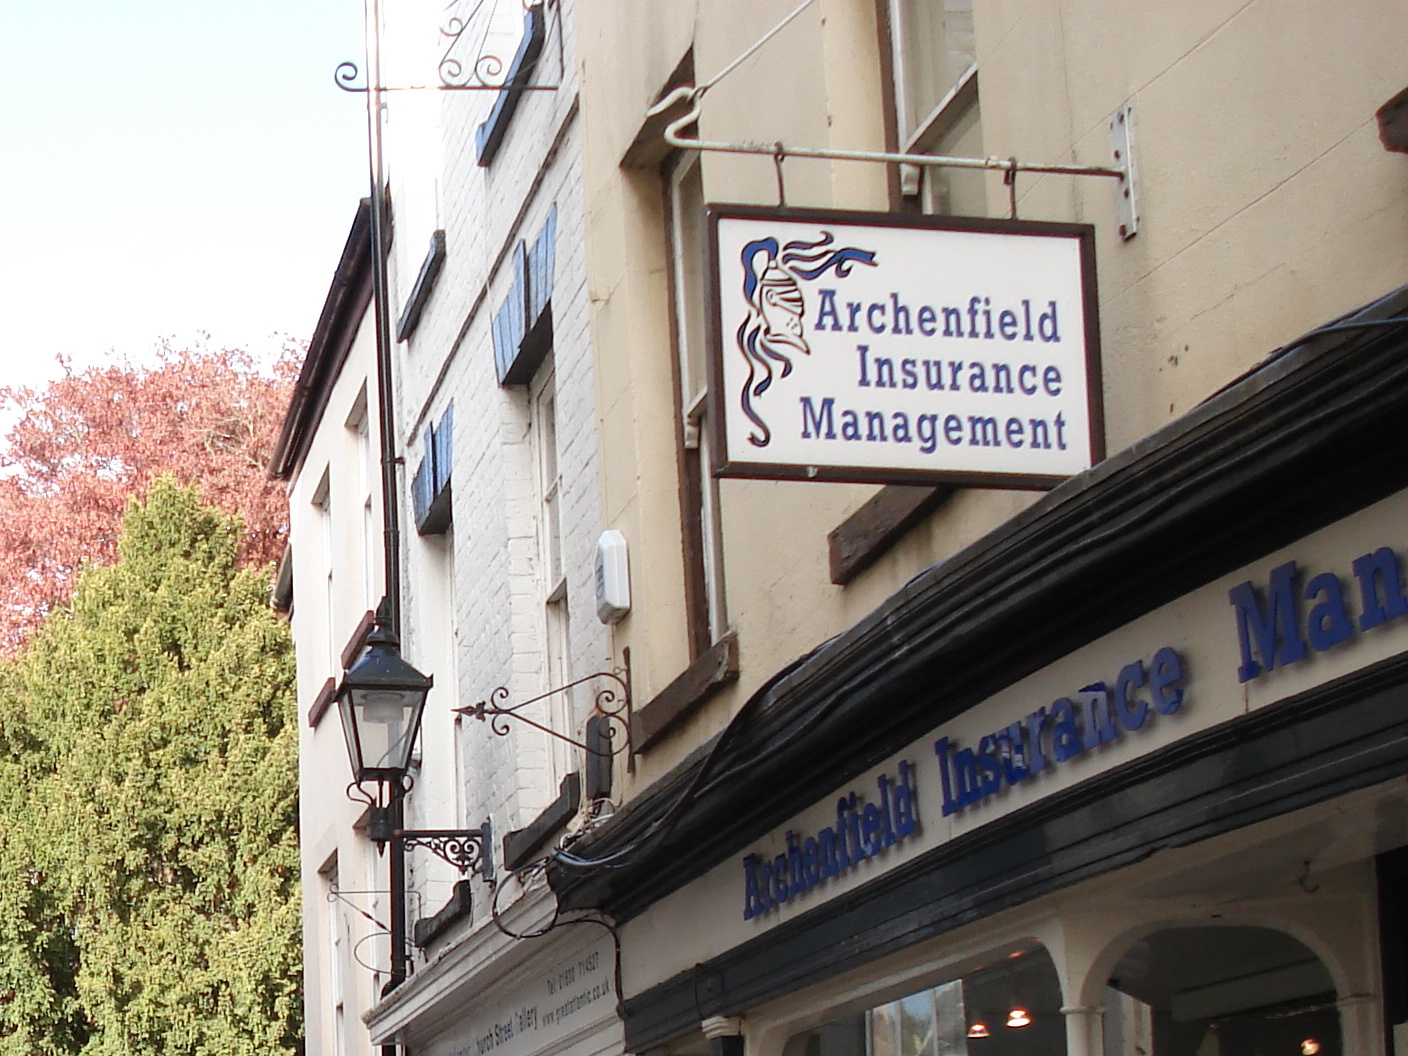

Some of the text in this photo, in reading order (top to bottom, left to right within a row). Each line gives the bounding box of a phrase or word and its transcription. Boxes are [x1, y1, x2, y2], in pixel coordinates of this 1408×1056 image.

[814, 289, 1061, 344] Archenfield
[857, 345, 1062, 397] Insurance
[800, 397, 1068, 454] Management
[743, 546, 1408, 921] Archenfield Insurance Man
